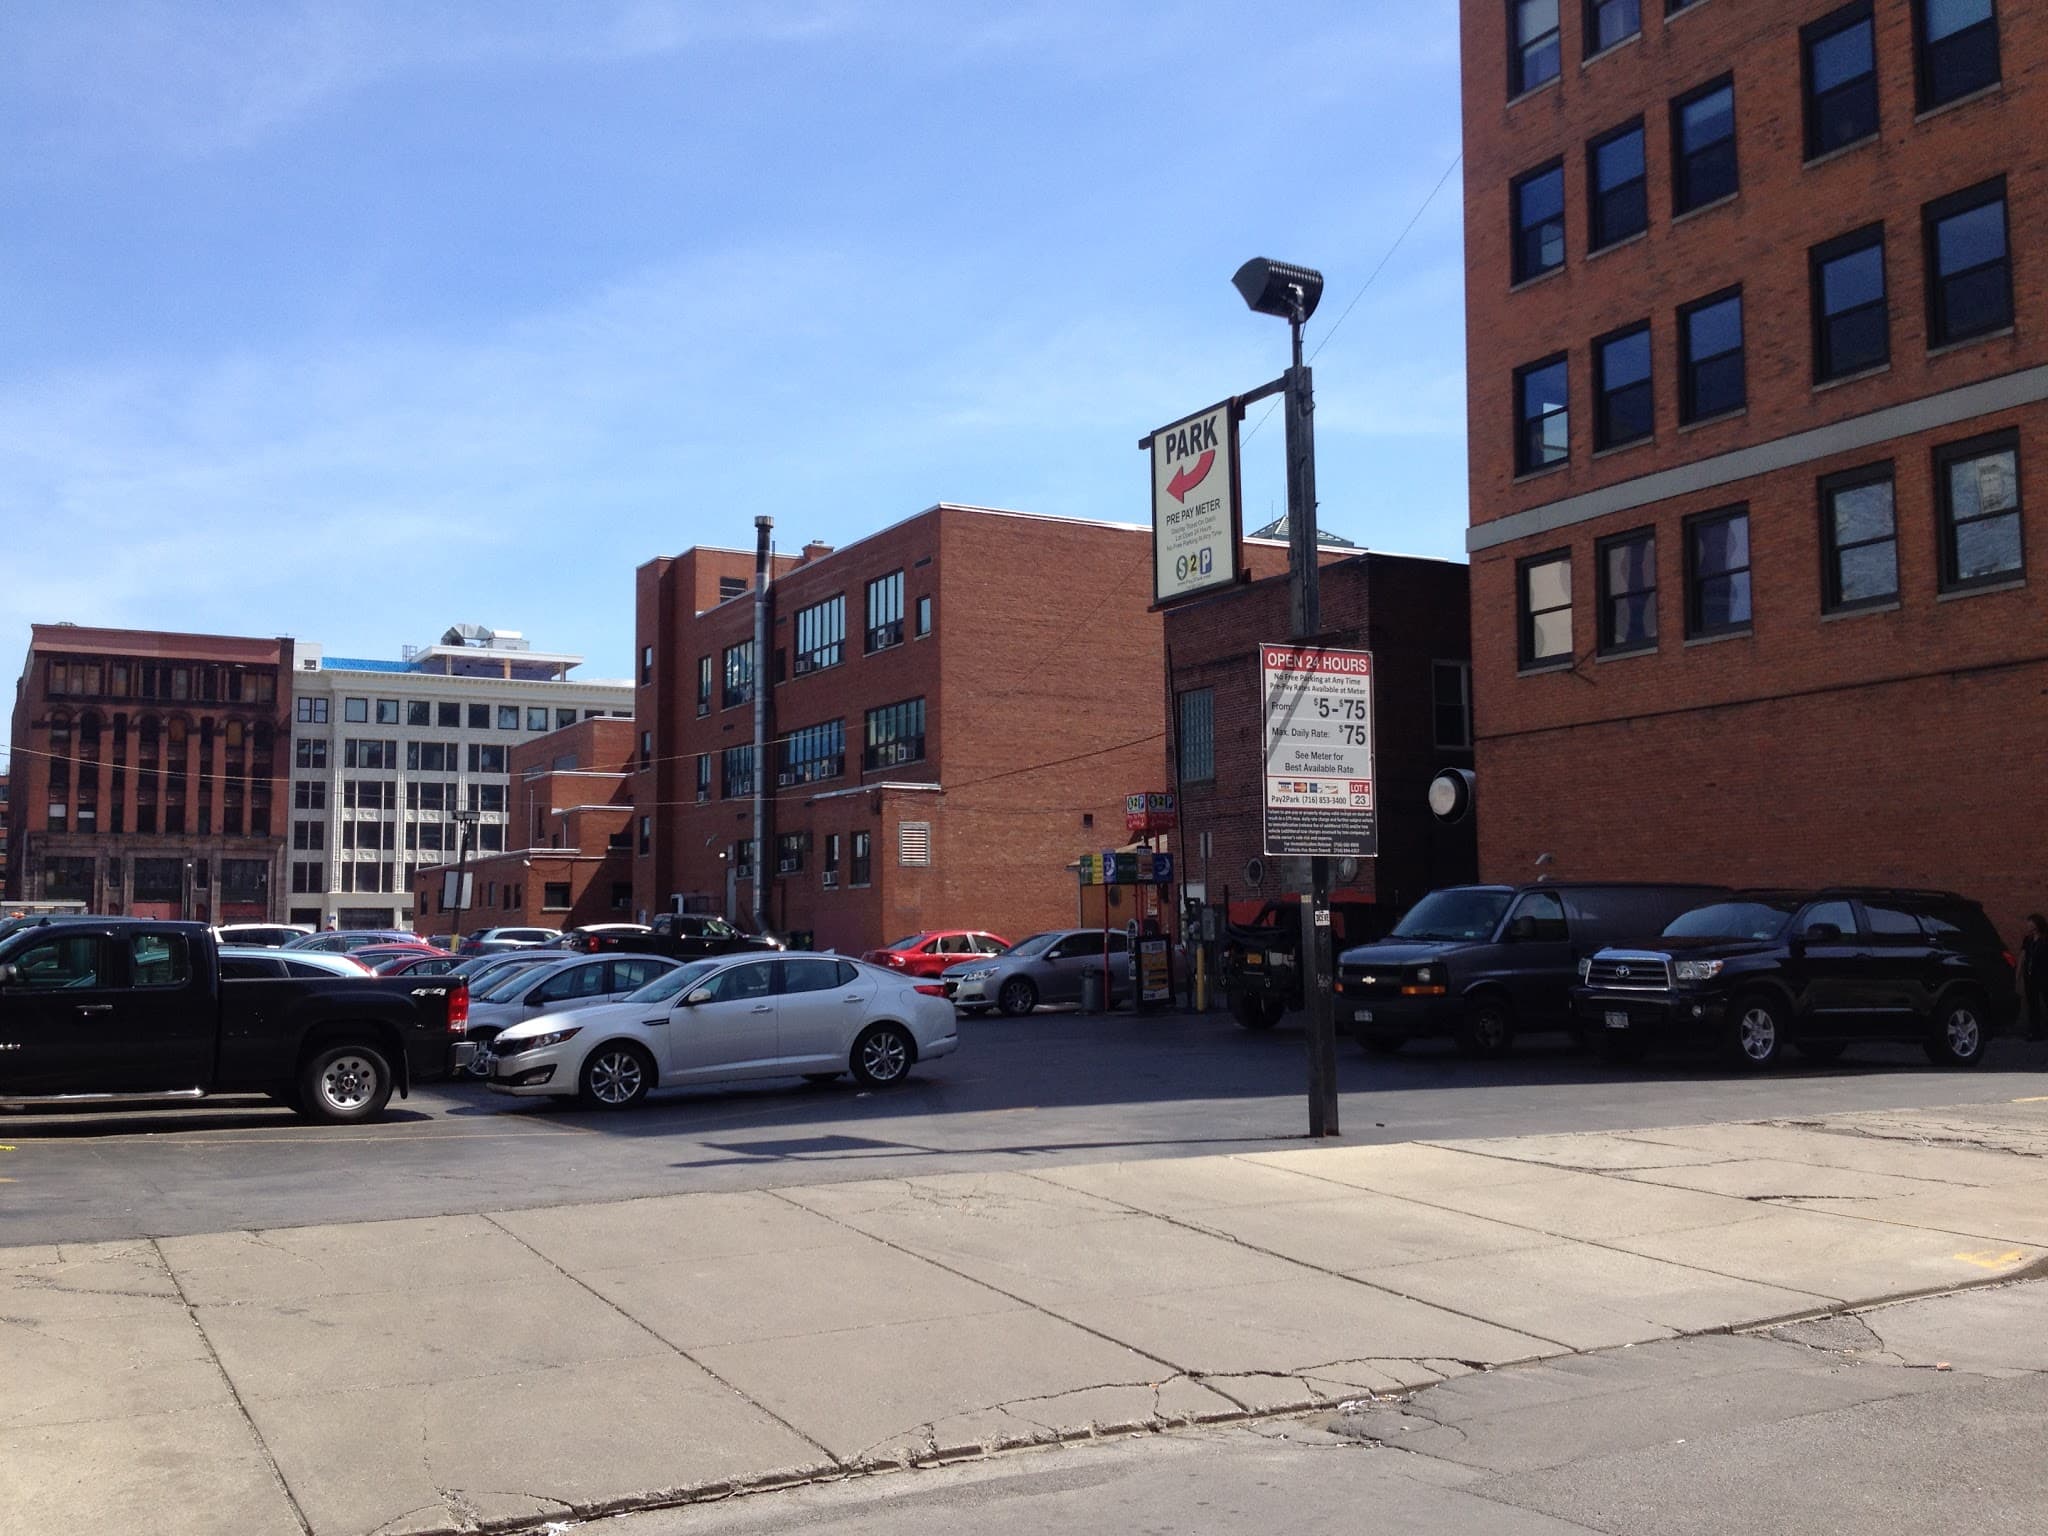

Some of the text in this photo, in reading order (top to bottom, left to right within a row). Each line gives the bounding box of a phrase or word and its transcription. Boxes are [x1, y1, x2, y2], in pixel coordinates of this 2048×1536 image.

[1166, 415, 1218, 464] PARK
[1166, 498, 1221, 526] PRE PAY METER
[1267, 652, 1367, 672] OPEN 24 HOURS
[1300, 674, 1323, 684] Parking
[1332, 676, 1345, 685] Any
[1345, 677, 1361, 685] Time
[1270, 682, 1292, 692] Pre-Pay
[1294, 683, 1310, 692] Rates
[1312, 684, 1339, 693] Available
[1347, 687, 1366, 695] Meter
[1271, 701, 1292, 711] From:
[1272, 727, 1289, 737] Max.
[1291, 728, 1309, 739] Daily
[1339, 724, 1366, 746] $75
[1295, 750, 1344, 761] See Meter for
[1285, 762, 1354, 774] Best Available Rate
[1350, 784, 1363, 793] LOT
[1271, 795, 1299, 805] Pay2Park
[1302, 795, 1318, 805] (716)
[1355, 795, 1366, 805] 23
